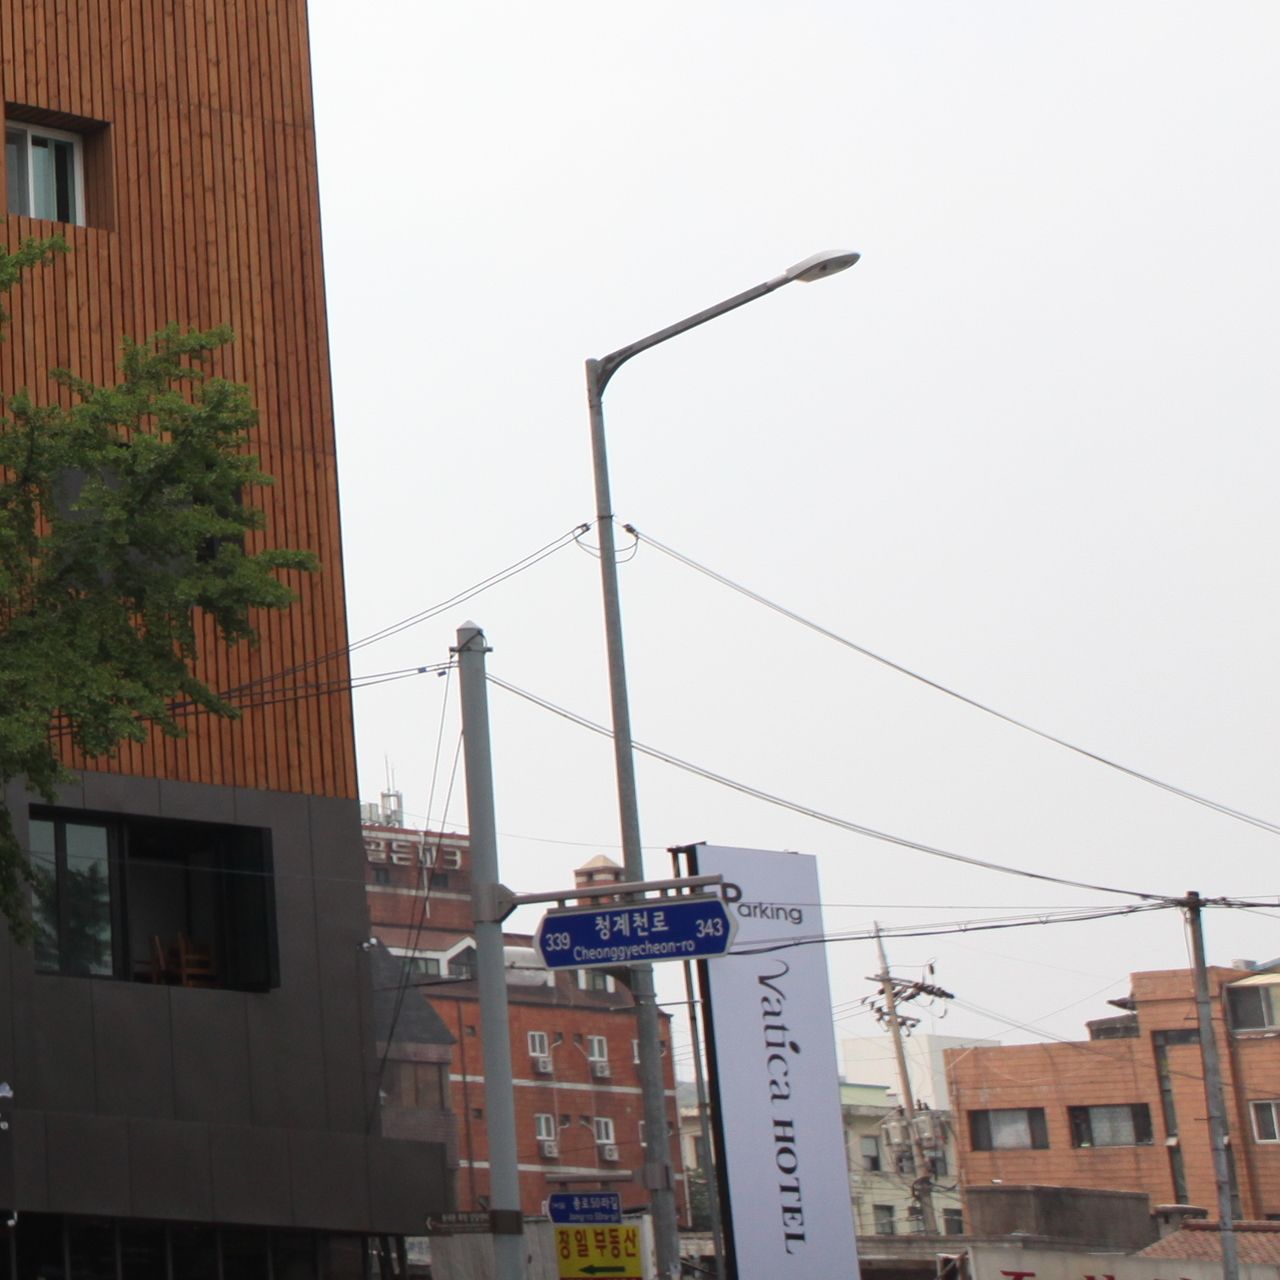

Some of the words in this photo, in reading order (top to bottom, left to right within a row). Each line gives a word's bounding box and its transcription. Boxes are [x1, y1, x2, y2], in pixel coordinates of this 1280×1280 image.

[594, 911, 670, 940] 청계천로
[695, 918, 724, 938] 343
[545, 932, 572, 952] 339
[573, 938, 696, 962] Cheonggyecheon-ro
[757, 958, 802, 1106] Vatica
[772, 1116, 808, 1256] HOTEL
[593, 1227, 638, 1259] 부동산
